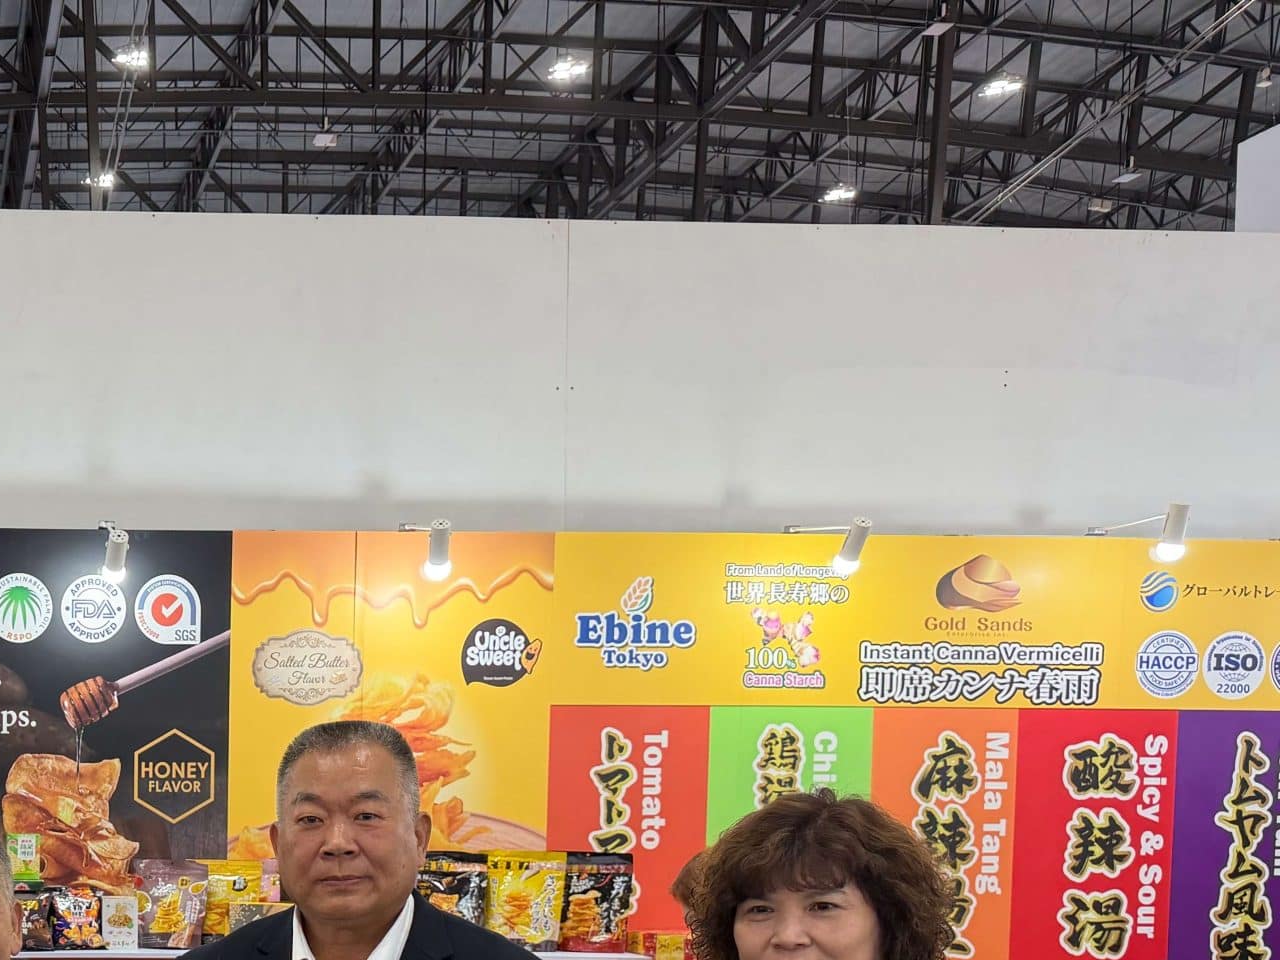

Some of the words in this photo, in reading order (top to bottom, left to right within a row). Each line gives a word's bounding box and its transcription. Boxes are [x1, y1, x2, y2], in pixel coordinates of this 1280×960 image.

[727, 564, 754, 576] From
[757, 564, 783, 576] Land
[785, 564, 798, 575] of
[799, 565, 849, 579] Longev
[70, 580, 119, 597] APPROVED
[725, 581, 849, 604] 世界長寿郷の
[72, 599, 117, 618] FDA
[68, 622, 118, 640] APPROVED
[576, 614, 695, 645] Ebine
[925, 616, 966, 631] Gold
[977, 617, 1033, 631] Sands
[6, 632, 33, 641] RSPO
[175, 629, 196, 641] SGS
[475, 630, 525, 651] Uncle
[1152, 637, 1185, 649] CERTIFIED
[263, 652, 307, 670] Salted
[307, 653, 349, 669] Butter
[466, 646, 522, 671] Sweet
[604, 650, 665, 669] Tokyo
[746, 647, 796, 669] 100%
[863, 644, 932, 662] Instant
[938, 645, 997, 662] Canna
[999, 645, 1101, 663] Vermicelli
[1139, 655, 1196, 669] HACCP
[1213, 653, 1258, 671] ISO
[287, 670, 325, 686] Flavor
[745, 674, 782, 687] Canna
[785, 673, 823, 687] Starch
[861, 668, 1100, 704] 即席カンナ春雨
[1164, 674, 1185, 687] SAFETY
[1217, 683, 1250, 694] 22000
[813, 731, 837, 786] Chi
[140, 761, 209, 779] HONEY
[984, 732, 1011, 810] Mala
[1137, 734, 1168, 822] Spicy
[148, 781, 201, 793] FLAVOR
[641, 730, 669, 850] Tomato
[1068, 741, 1134, 953] 酸辣湯
[1140, 830, 1164, 856] &
[975, 819, 1007, 895] Tang
[1137, 864, 1163, 938] Sour
